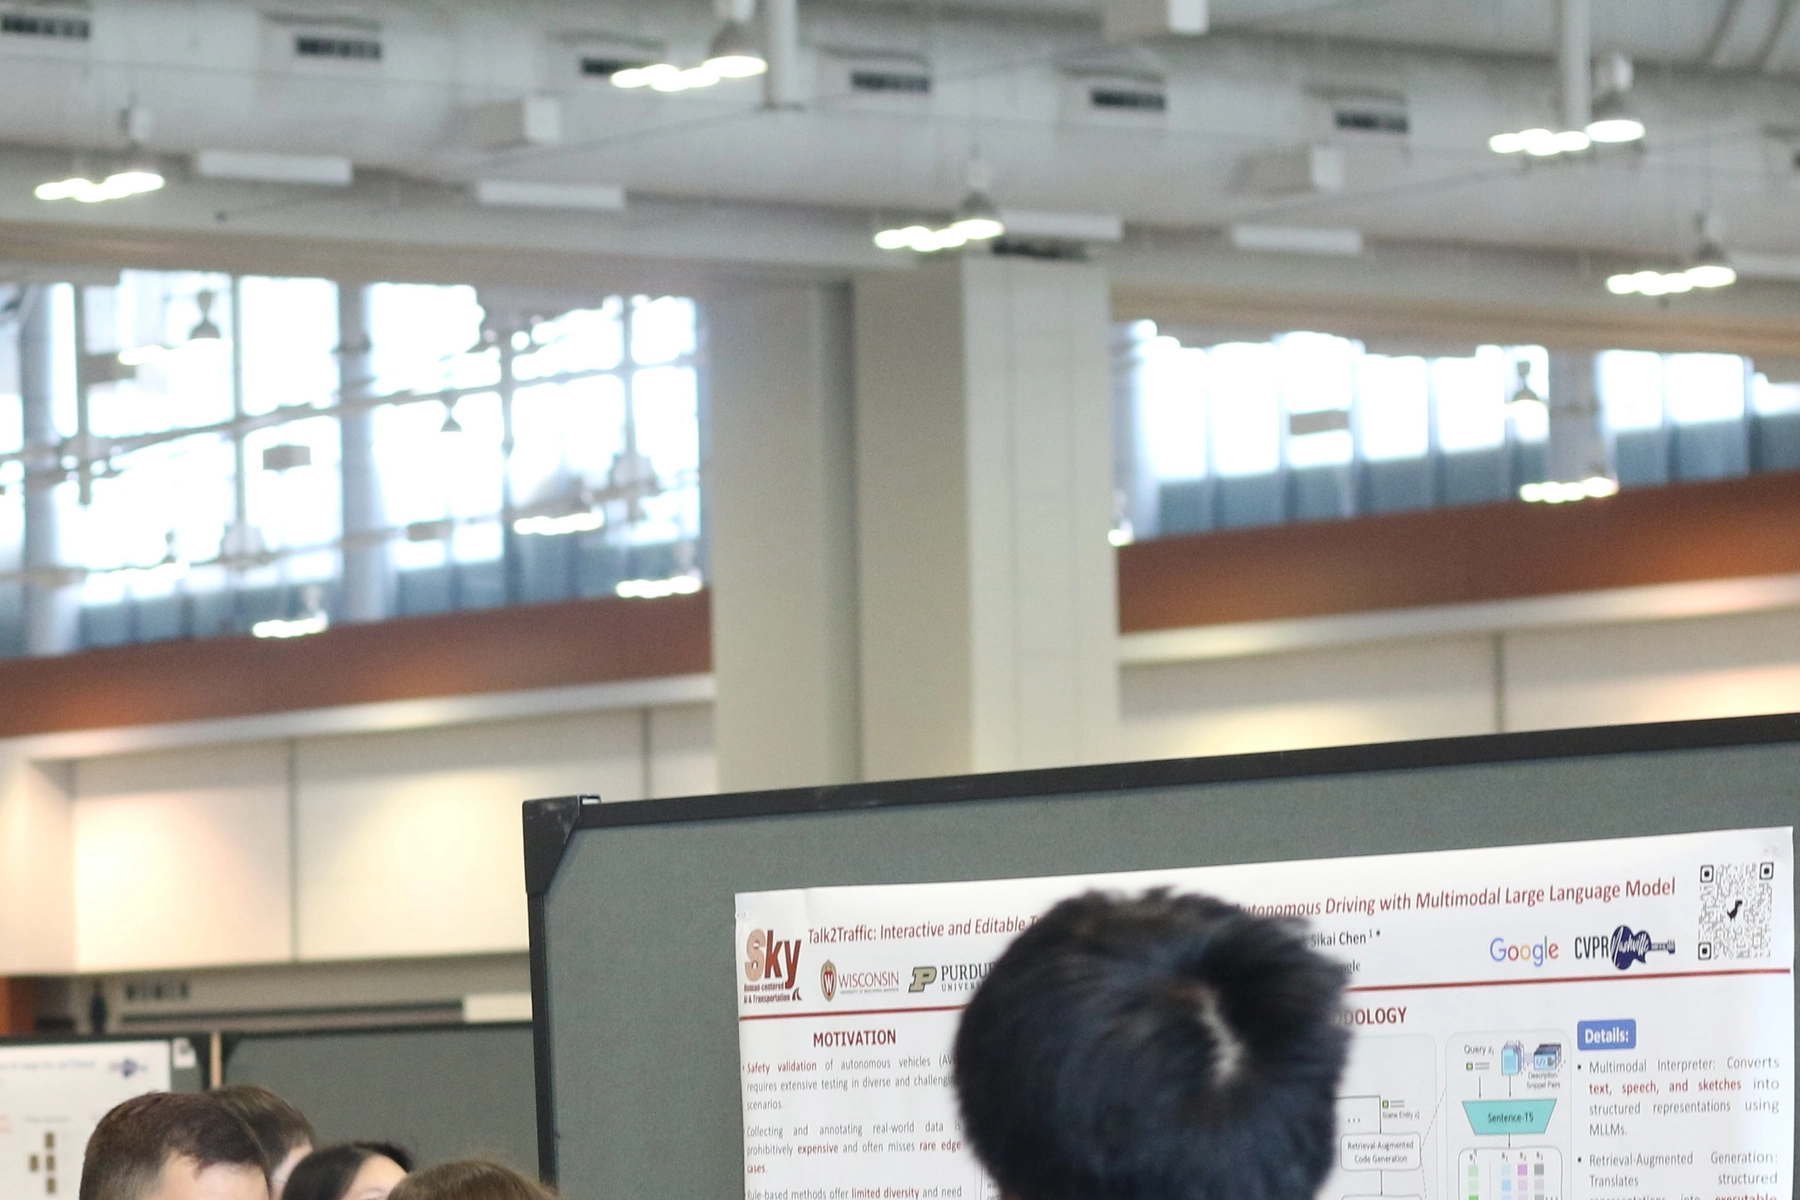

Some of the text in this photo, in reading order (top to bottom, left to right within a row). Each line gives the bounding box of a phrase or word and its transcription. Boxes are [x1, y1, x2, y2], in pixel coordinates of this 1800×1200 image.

[808, 926, 876, 944] Talk2Traffic:
[880, 920, 944, 940] Interactive
[948, 920, 970, 936] and
[974, 918, 1026, 934] Editable
[1325, 896, 1375, 916] Driving
[1380, 894, 1410, 911] with
[1416, 888, 1500, 909] Multimodal
[1505, 887, 1544, 908] Large
[1550, 882, 1620, 903] Language
[1626, 877, 1676, 896] Model
[1490, 936, 1559, 967] Google
[1574, 935, 1609, 960] CVPR
[744, 928, 802, 989] Sky
[838, 971, 900, 989] WISCONSIN
[813, 1030, 896, 1048] MOTIVATION
[1585, 1027, 1629, 1044] Details:
[778, 1056, 930, 1073] validation of autonomous vehicles
[1590, 1057, 1779, 1073] Multimodal Interpreter: Converts
[781, 1074, 910, 1091] extensive testing diverse and
[1622, 1079, 1779, 1094] speech, and sketches into
[1590, 1100, 1779, 1115] structured representations using
[794, 1120, 943, 1136] and annotating data
[798, 1139, 962, 1155] expensive and often misses rare edge
[1373, 1155, 1407, 1163] Generation
[1590, 1153, 1693, 1168] Retrieval-Augmented
[747, 1164, 767, 1174] cases.
[1590, 1173, 1778, 1187] Translates structured
[792, 1186, 962, 1200] methods limited diversity and need
